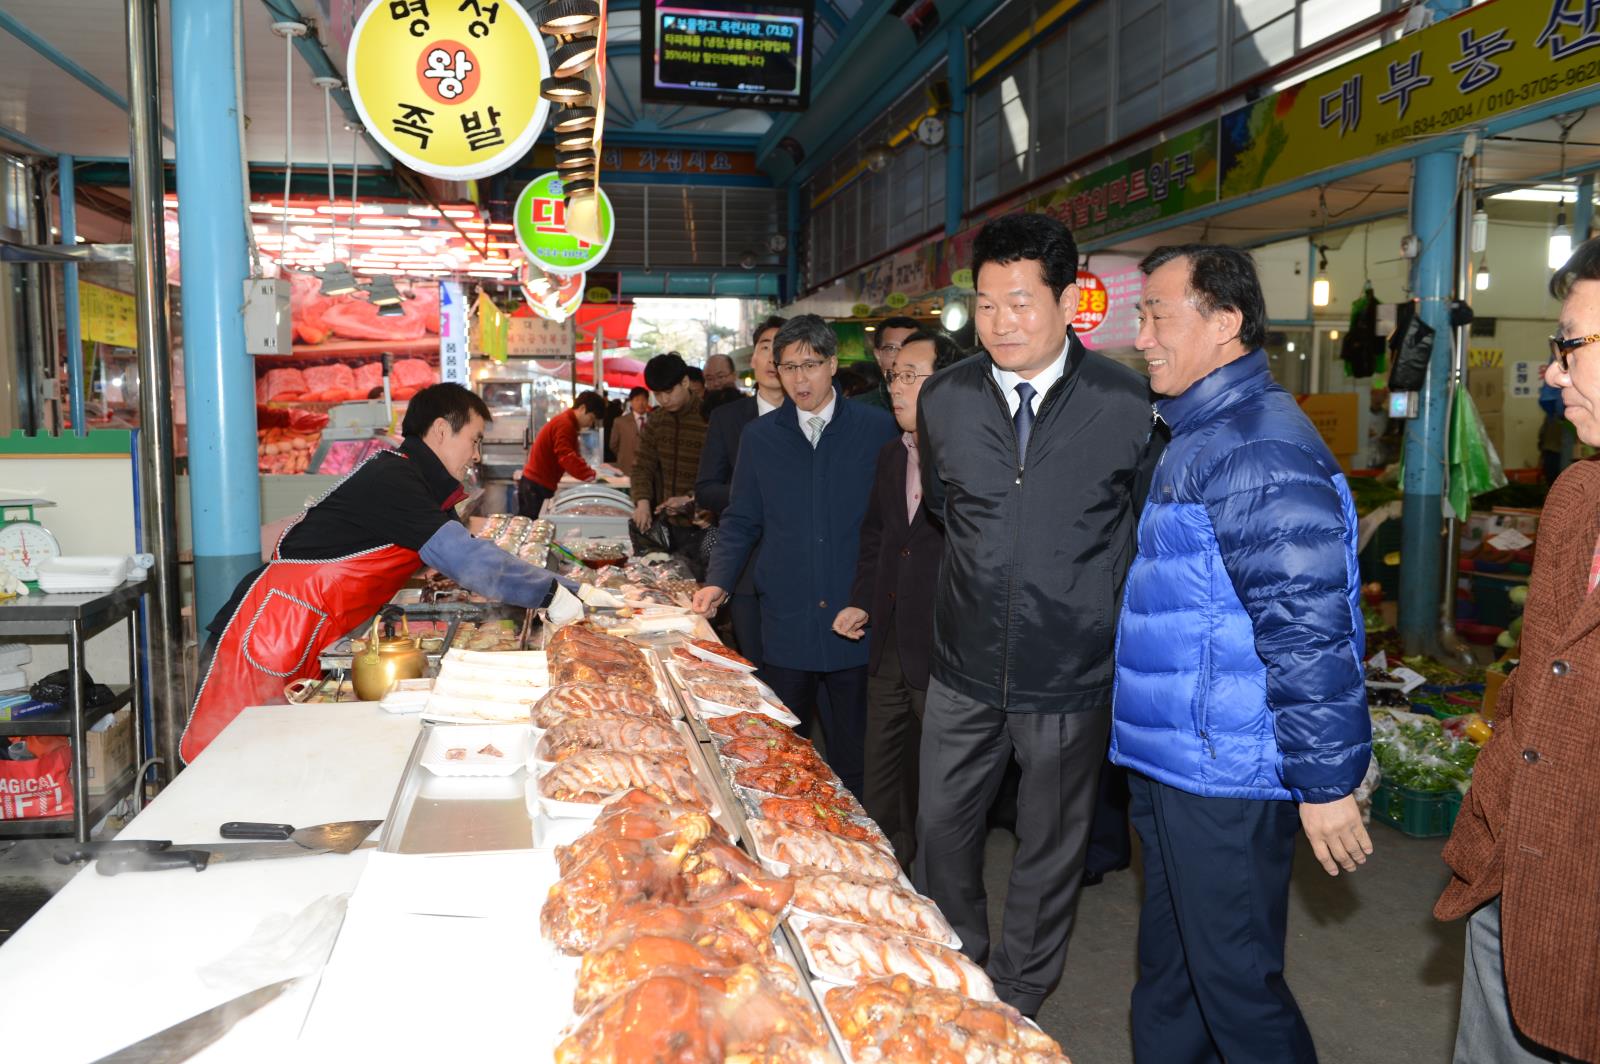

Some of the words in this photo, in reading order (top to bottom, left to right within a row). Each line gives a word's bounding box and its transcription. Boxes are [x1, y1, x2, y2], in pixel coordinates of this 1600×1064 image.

[423, 47, 473, 99] 왕
[392, 102, 505, 151] 족발
[1412, 103, 1473, 136] 834-2004
